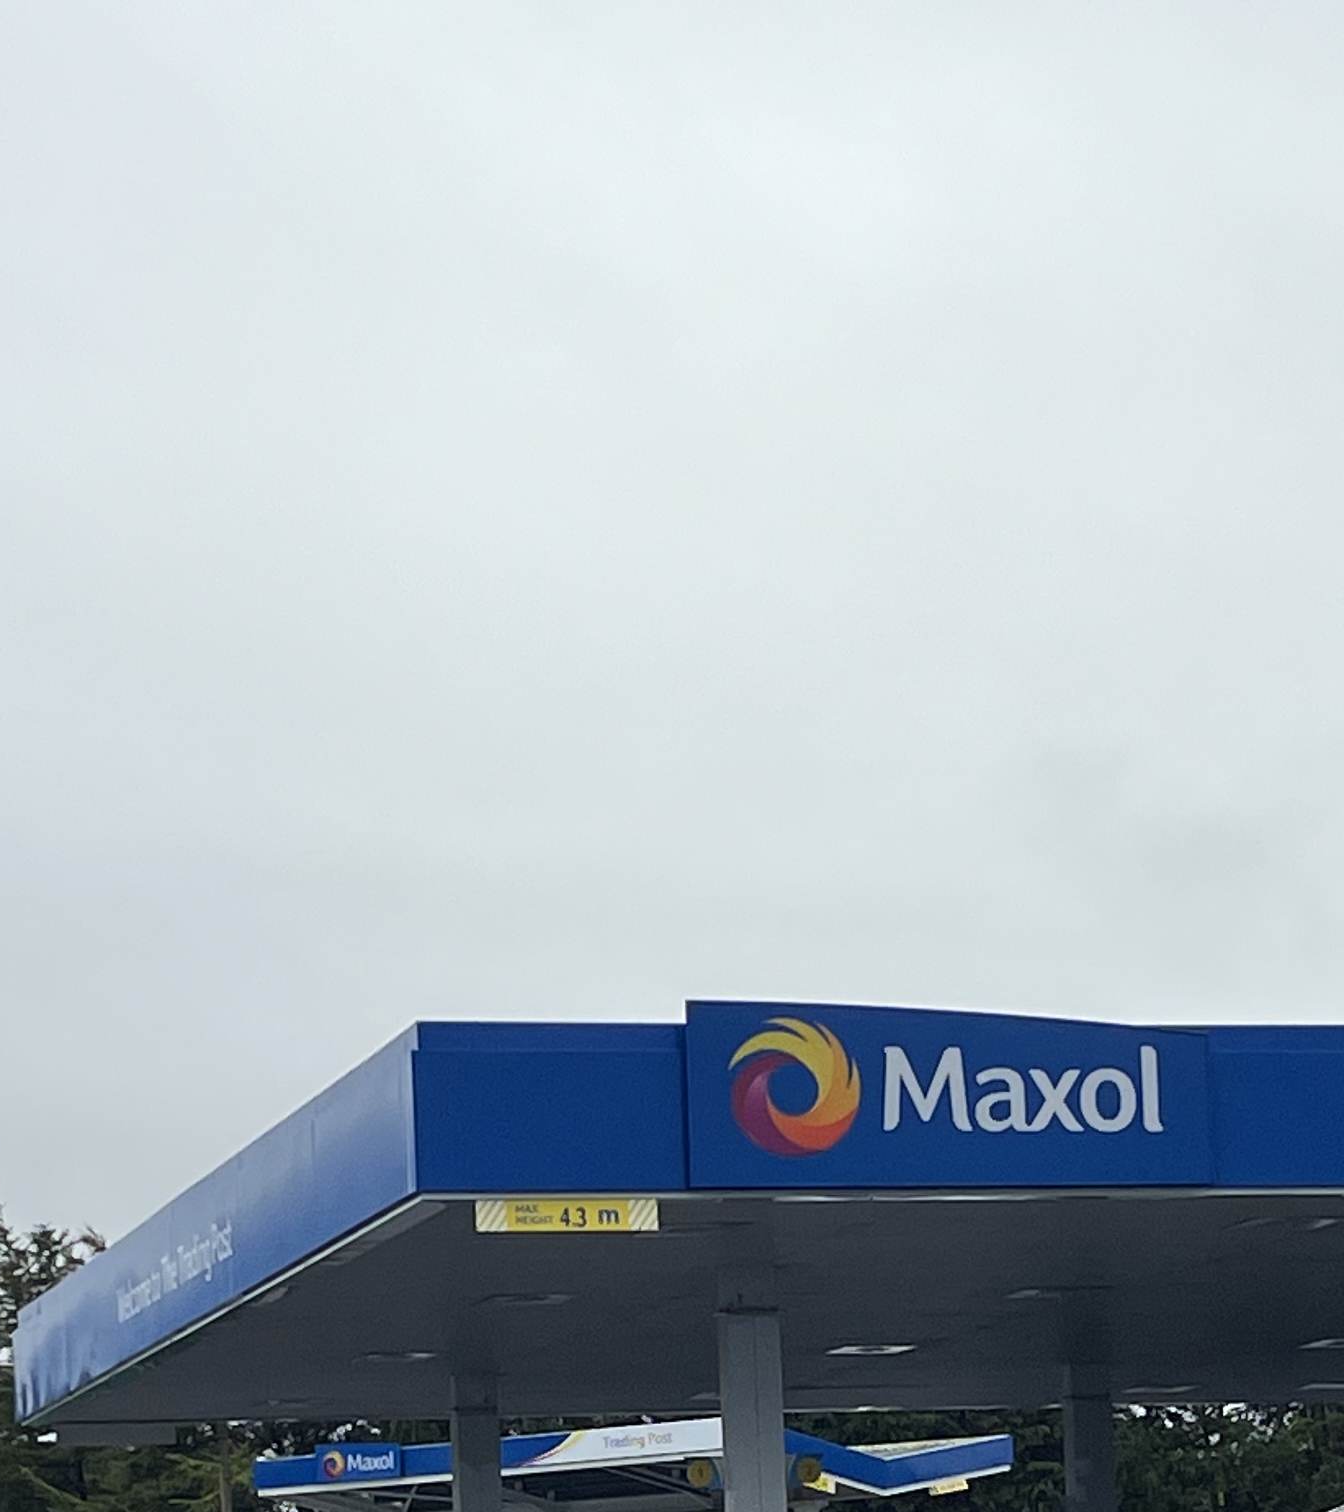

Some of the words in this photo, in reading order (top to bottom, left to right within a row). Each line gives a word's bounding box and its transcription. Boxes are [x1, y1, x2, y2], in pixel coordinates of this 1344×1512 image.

[883, 1045, 1164, 1133] Maxol
[514, 1204, 539, 1213] MAX
[598, 1208, 620, 1225] m
[514, 1214, 554, 1225] HEIGHT
[176, 1234, 213, 1286] Trading
[210, 1221, 233, 1262] Post
[603, 1435, 646, 1449] Trading
[647, 1432, 673, 1446] Post
[346, 1450, 394, 1472] Maxol
